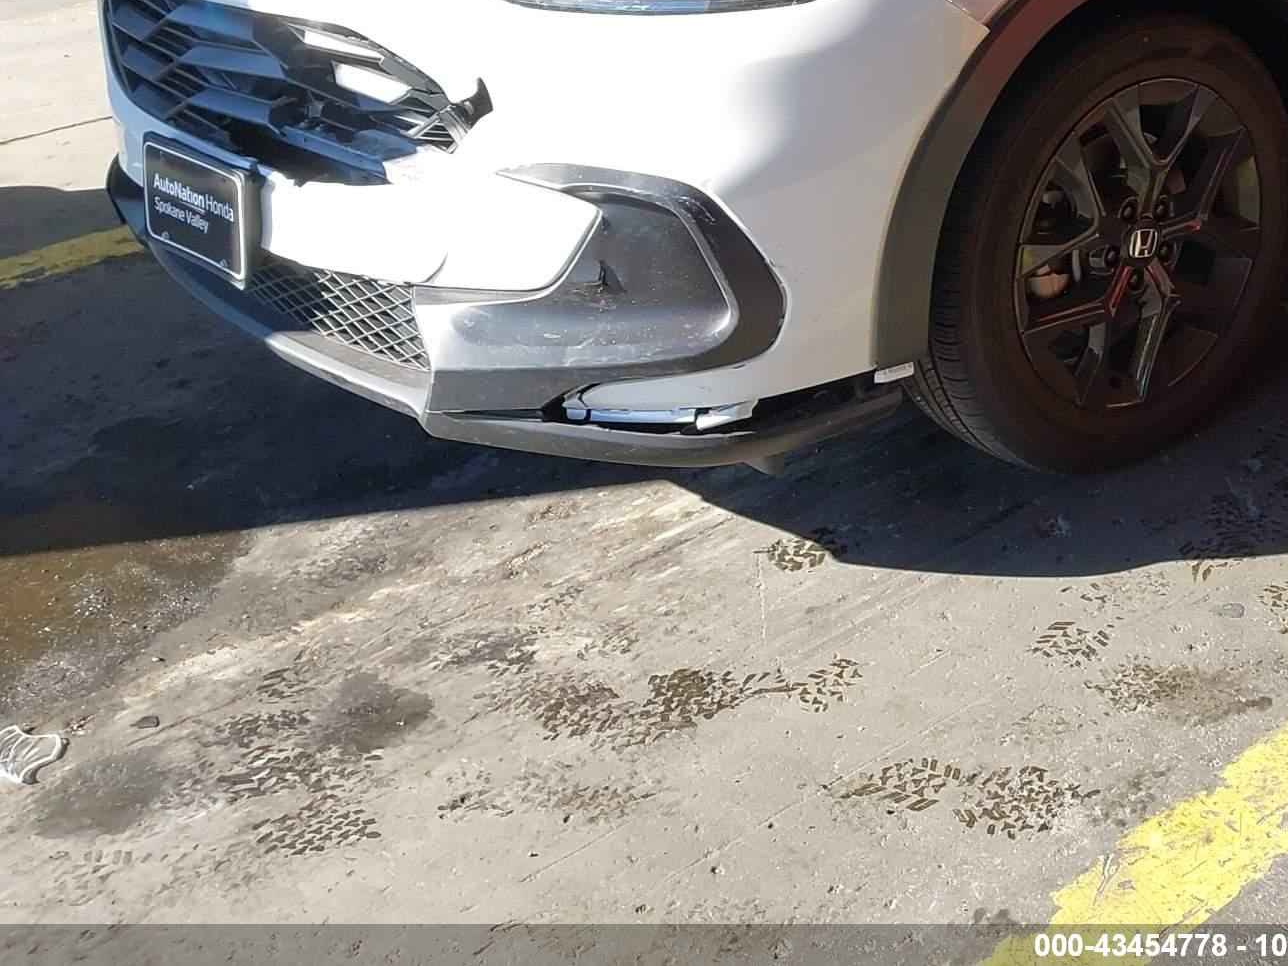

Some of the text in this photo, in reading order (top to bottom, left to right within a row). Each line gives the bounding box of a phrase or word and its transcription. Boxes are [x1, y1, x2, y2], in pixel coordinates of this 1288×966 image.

[153, 173, 234, 222] AutoNation Honda
[154, 196, 208, 234] Spokane Valley
